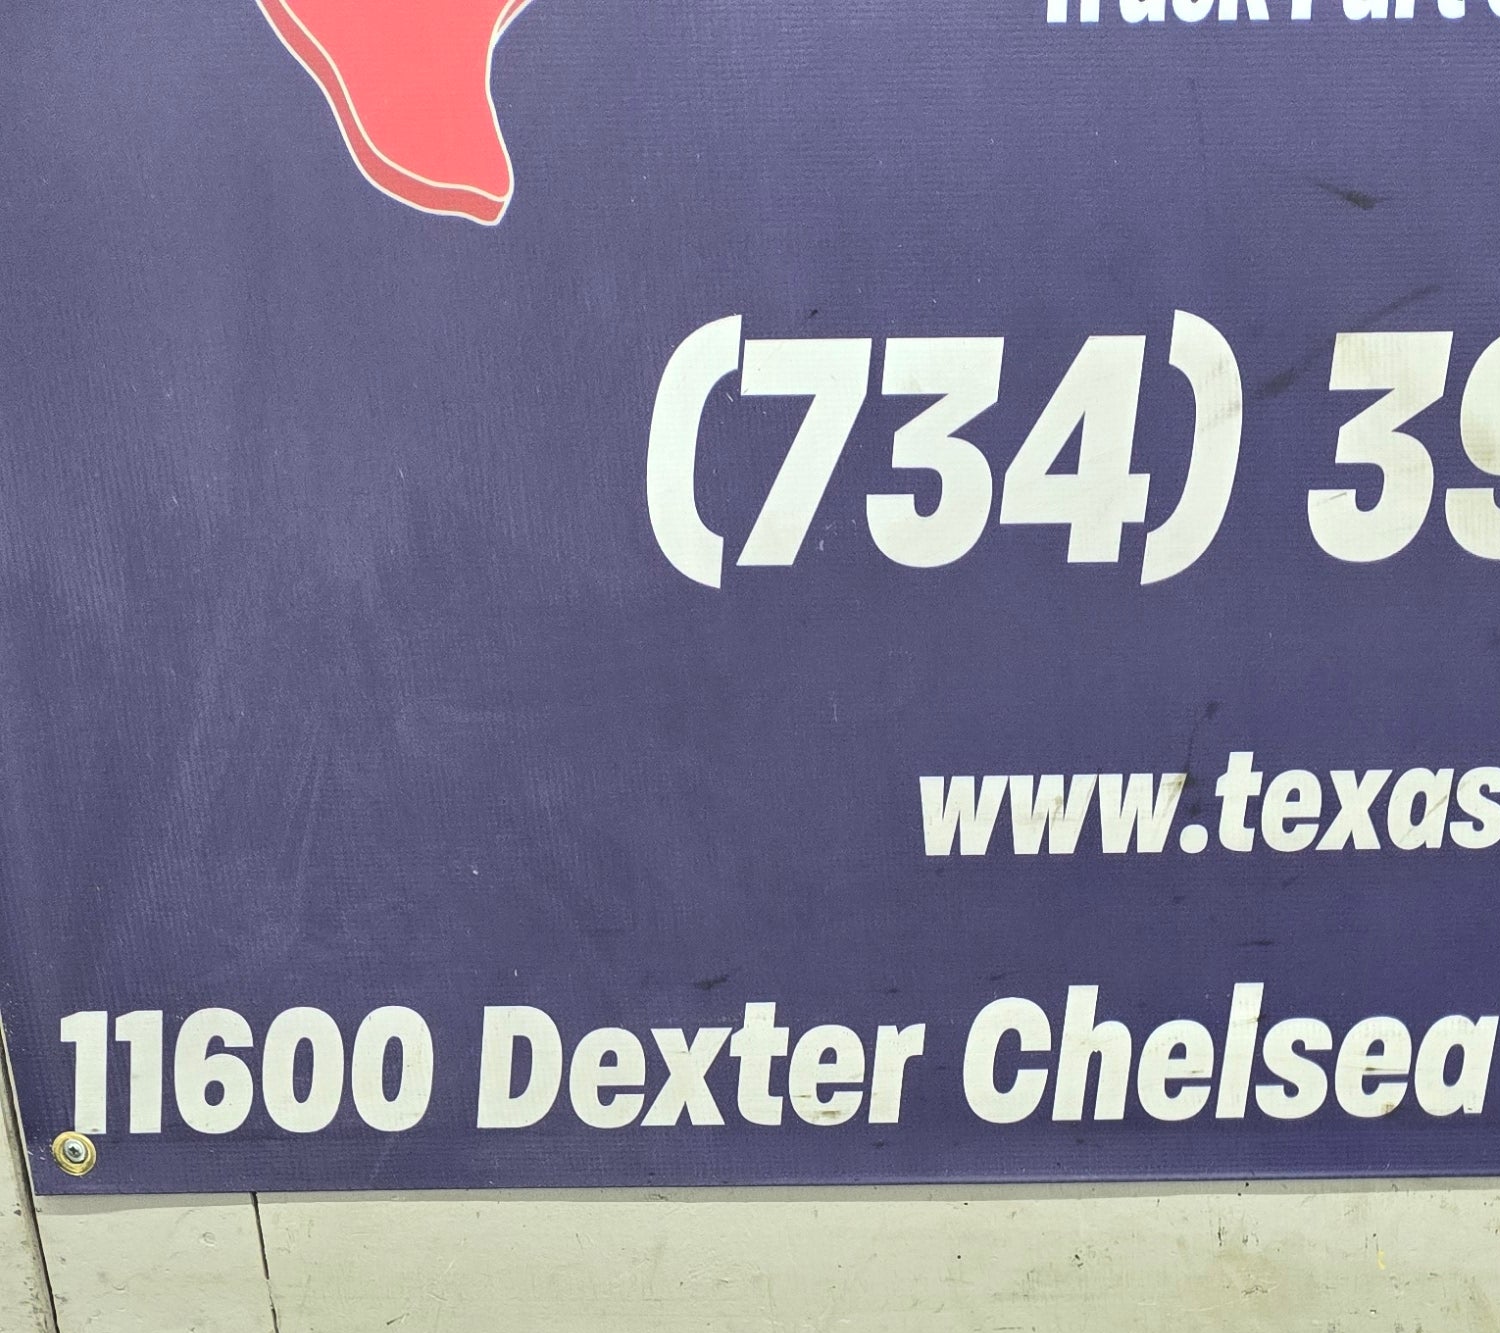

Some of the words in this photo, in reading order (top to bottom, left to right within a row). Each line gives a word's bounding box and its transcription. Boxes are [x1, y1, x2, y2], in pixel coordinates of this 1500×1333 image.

[646, 308, 1243, 589] (734)
[59, 1005, 434, 1135] 11600
[476, 1001, 926, 1130] Dexter
[962, 982, 1500, 1124] Chelsea
